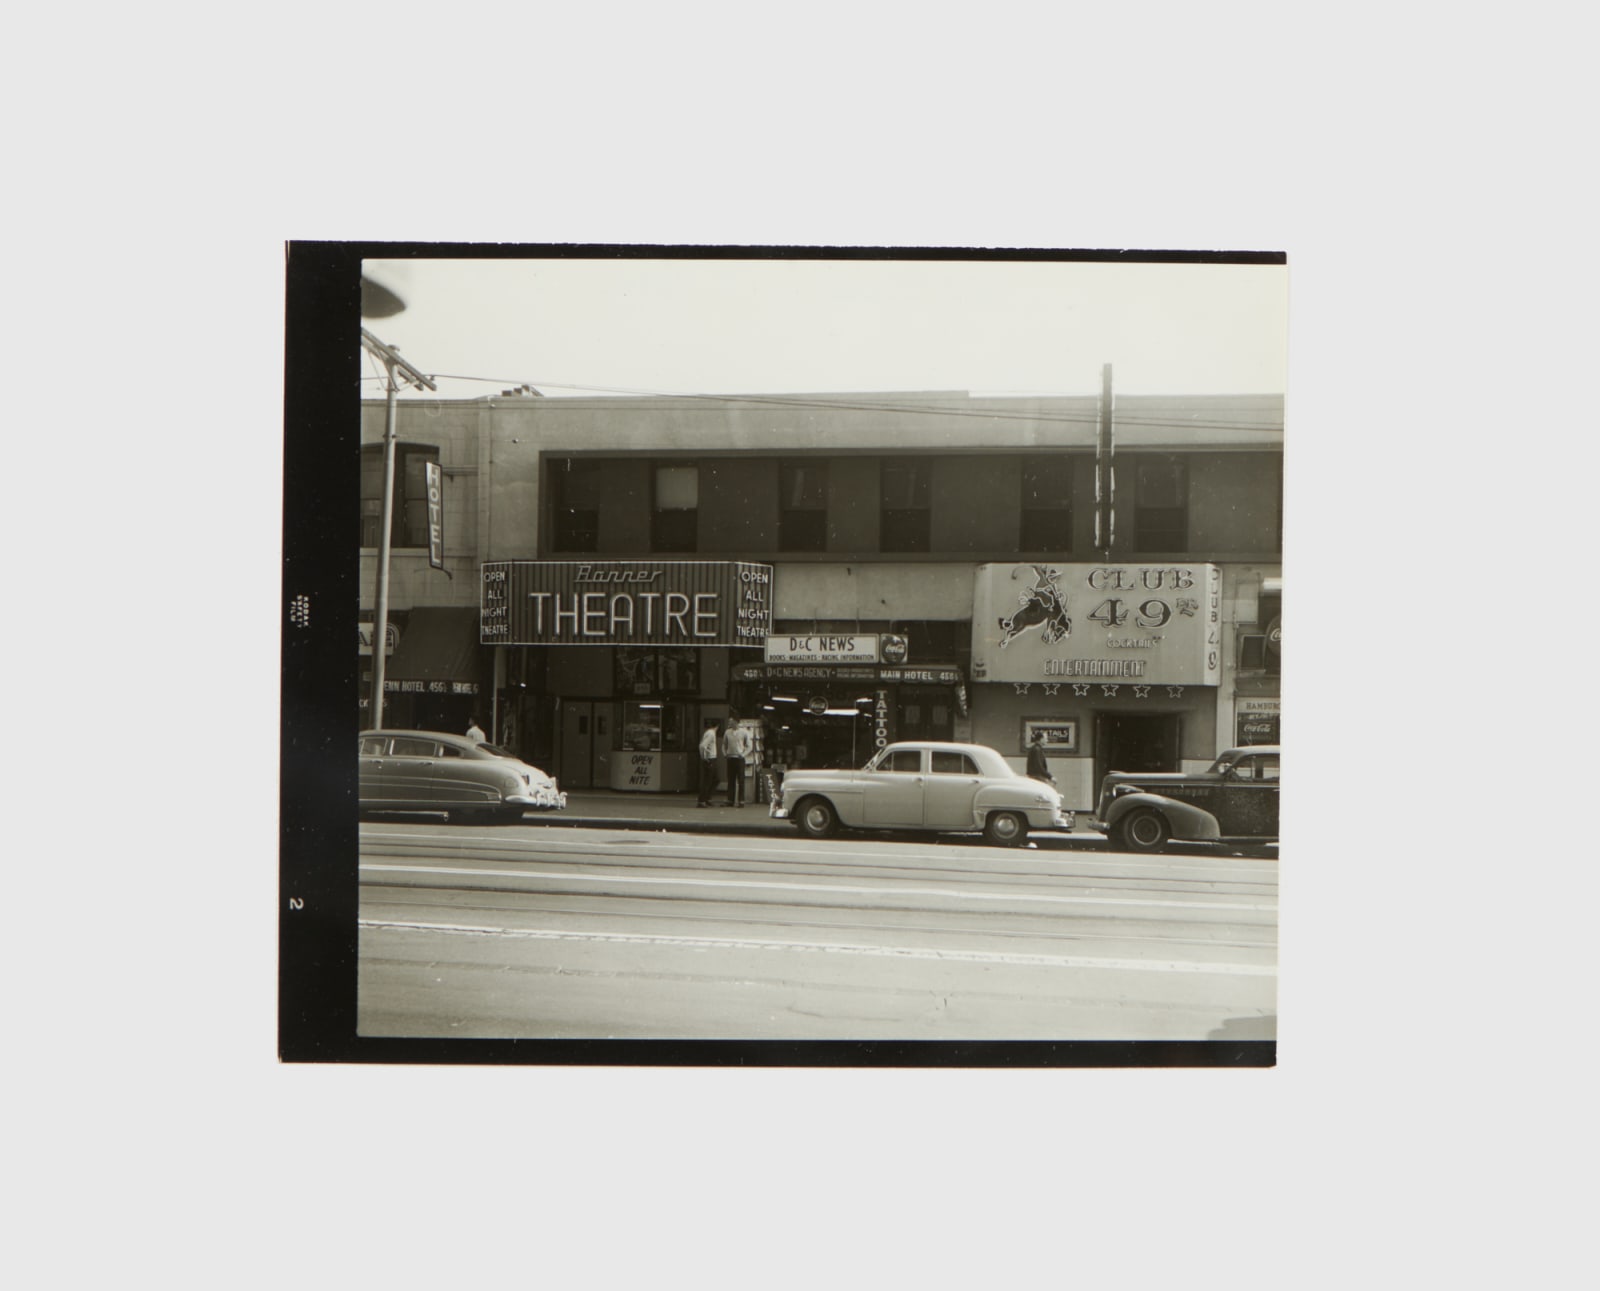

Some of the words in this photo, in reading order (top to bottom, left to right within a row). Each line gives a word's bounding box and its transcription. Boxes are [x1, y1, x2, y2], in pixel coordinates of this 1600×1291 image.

[429, 468, 441, 563] HOTEL
[483, 571, 505, 582] OPEN
[574, 565, 663, 583] Banner
[741, 571, 768, 584] OPEN
[1087, 568, 1194, 591] CLUB
[487, 589, 503, 600] ALL
[746, 590, 764, 602] ALL
[481, 606, 507, 617] NIGHT
[528, 592, 718, 637] THEATRE
[738, 608, 769, 620] NIGHT
[481, 624, 509, 636] THEATRE
[736, 625, 769, 638] THEATRE
[789, 637, 812, 652] D&C
[819, 637, 855, 652] NEWS
[1043, 659, 1146, 677] ENTERTAINMENT
[880, 670, 900, 680] MAIN
[904, 671, 933, 680] HOTEL
[401, 681, 425, 693] HOTEL
[876, 690, 887, 747] TATTOO
[631, 755, 654, 766] OPEN
[634, 766, 648, 775] ALL
[628, 776, 650, 786] NITE
[289, 897, 304, 911] 2
